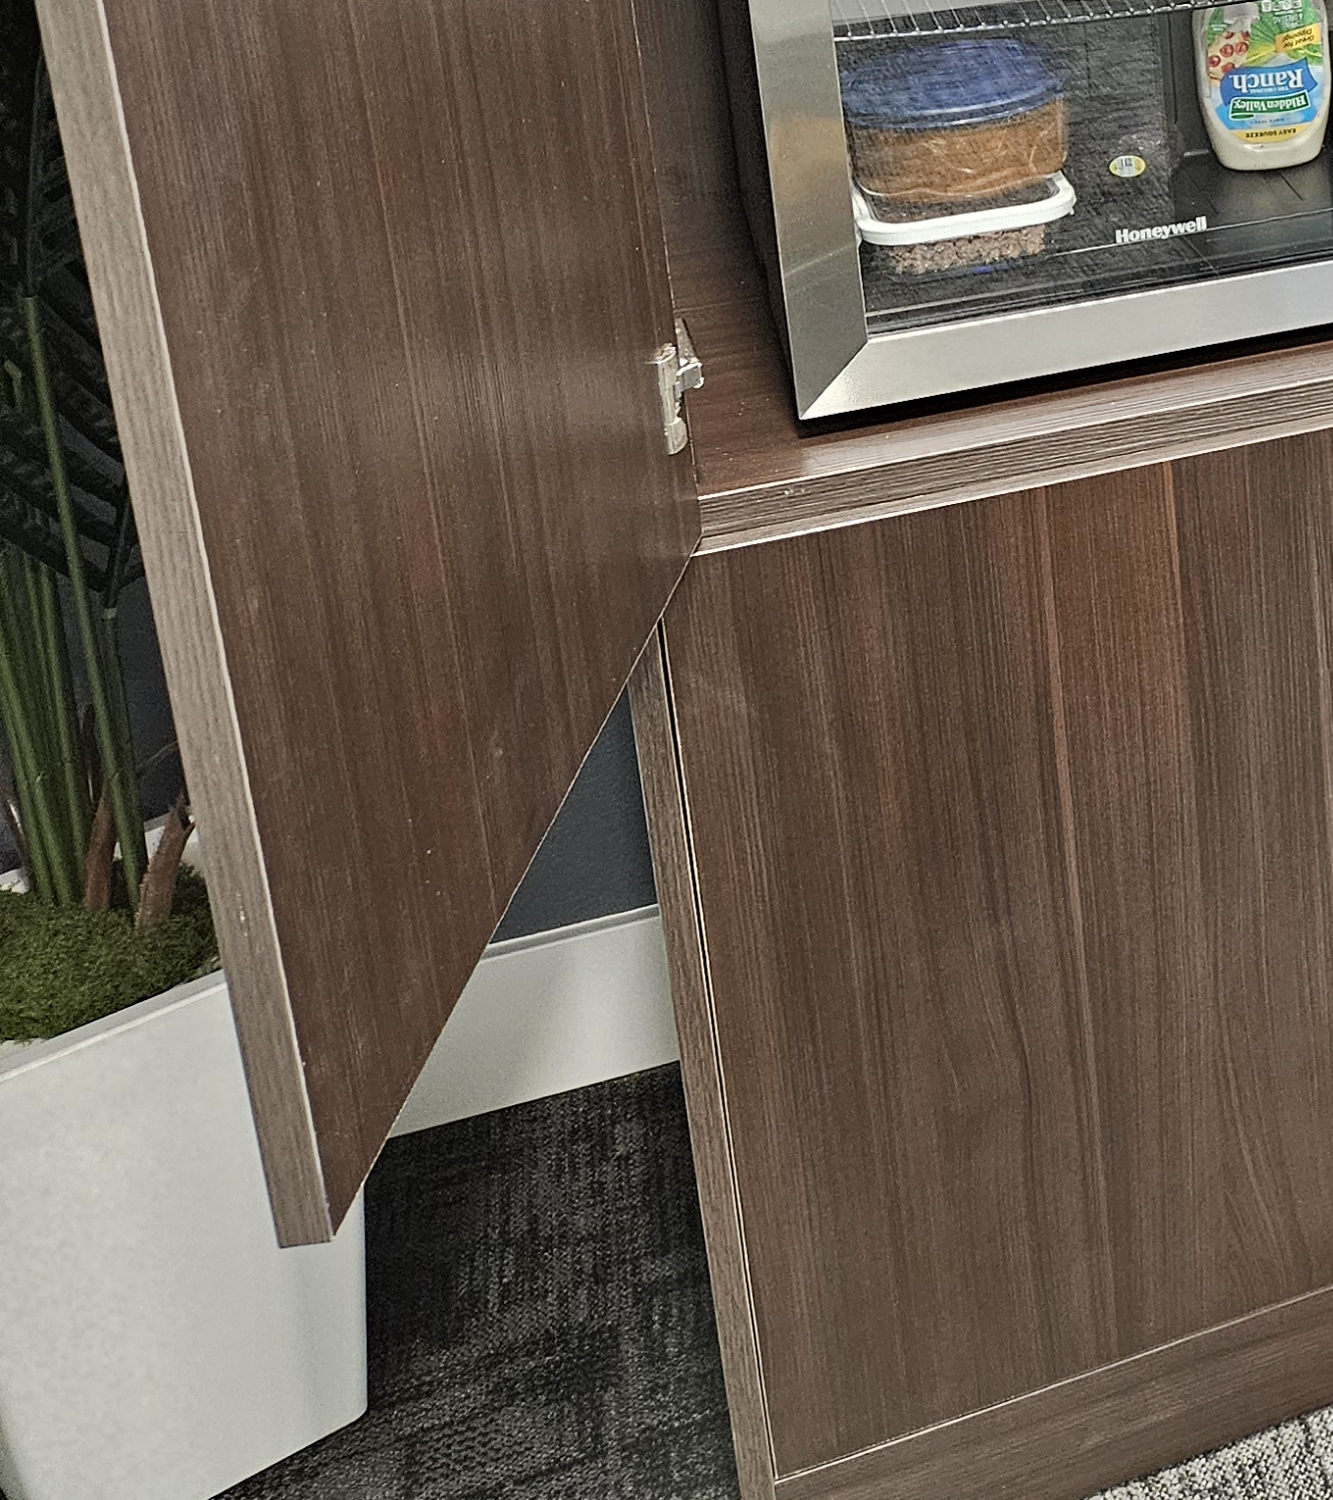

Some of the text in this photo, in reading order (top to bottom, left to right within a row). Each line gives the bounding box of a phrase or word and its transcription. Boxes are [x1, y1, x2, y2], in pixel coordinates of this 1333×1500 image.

[1282, 34, 1316, 48] Great for
[1267, 94, 1307, 109] Hidden
[1245, 127, 1297, 139] EASY SQUEEZE
[1114, 215, 1208, 244] Honeywell
